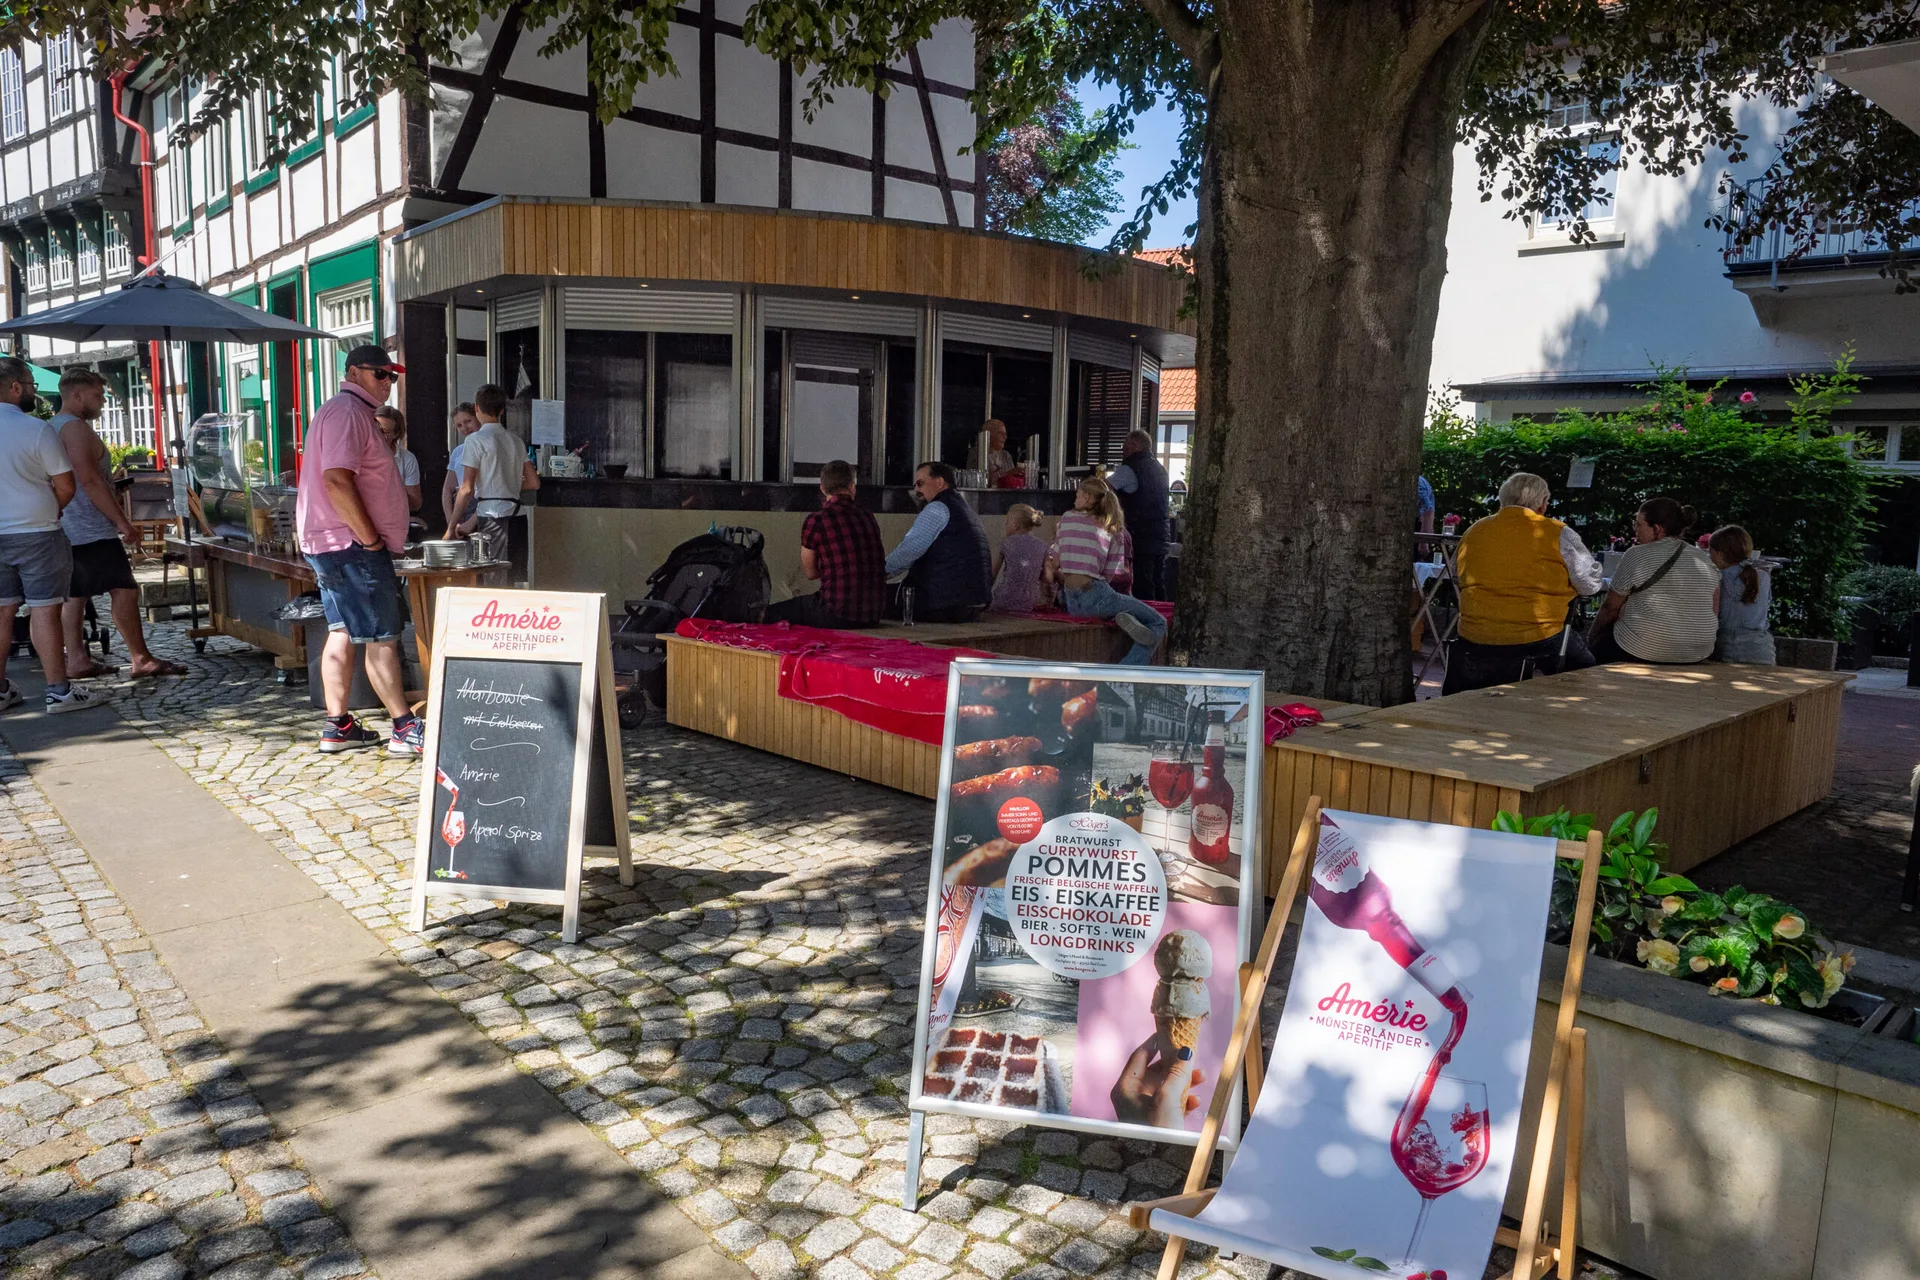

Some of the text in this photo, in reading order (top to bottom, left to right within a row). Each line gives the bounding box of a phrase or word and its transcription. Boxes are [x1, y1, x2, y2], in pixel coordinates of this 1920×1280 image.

[471, 600, 562, 630] Amérie
[471, 631, 558, 643] MÜNSTERLÄNDER
[492, 642, 537, 651] APERITIF
[469, 818, 504, 844] Aperol
[1055, 835, 1122, 848] BRATWURST
[1038, 844, 1138, 861] CURRYWURST
[1028, 855, 1147, 883] POMMES
[1014, 875, 1159, 894] FRISCHE BELGISCHE WAFFELN
[1011, 885, 1160, 912] EIS EISKAFFEE
[1017, 904, 1152, 927] EISSCHOKOLADE
[1021, 919, 1146, 939] BIER SOFTS WEIN
[1030, 933, 1135, 954] LONGDRINKS
[1317, 982, 1428, 1032] Amérie
[1316, 1015, 1422, 1048] MÜNSTERLÄNDER
[1337, 1031, 1394, 1051] APERITIF
